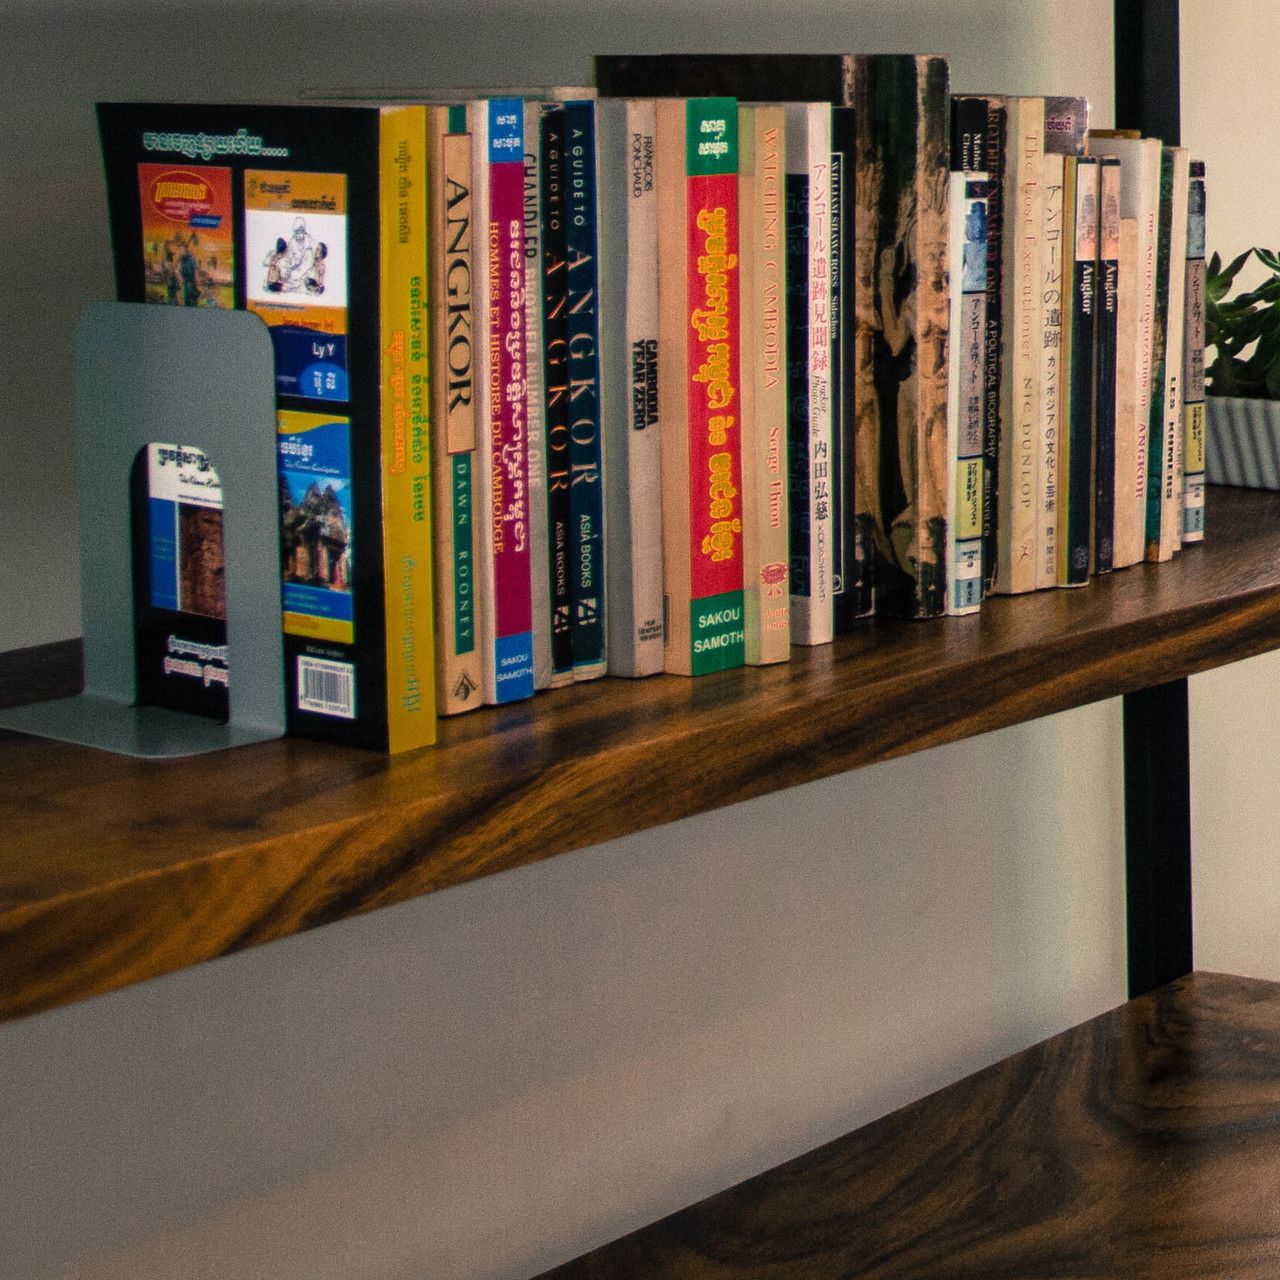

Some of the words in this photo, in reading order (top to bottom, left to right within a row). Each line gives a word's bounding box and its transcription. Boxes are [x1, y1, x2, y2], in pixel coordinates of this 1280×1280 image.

[549, 148, 559, 202] GUIDE
[571, 147, 584, 199] GUIDE
[633, 133, 642, 198] PONCHAUD
[1025, 134, 1038, 168] The
[572, 203, 585, 227] TO
[763, 127, 780, 251] WATCHING
[1025, 182, 1037, 225] Lost
[488, 222, 499, 299] HOMMES
[1043, 185, 1063, 349] アンコールの遺跡
[446, 178, 473, 413] ANGKOR
[1022, 235, 1036, 361] Executioner
[1082, 264, 1094, 315] Angkor
[1105, 264, 1117, 312] Angkor
[489, 307, 500, 327] ET
[763, 261, 780, 389] CAMBODIA
[490, 334, 501, 415] HISTOIRE
[546, 250, 568, 493] ANGKOR
[567, 245, 599, 486] ANGKOR
[632, 339, 645, 384] YEAR
[646, 339, 659, 426] CAMBODIA
[988, 330, 997, 387] POLITICAL
[633, 387, 646, 432] ZERO
[818, 377, 827, 413] Angkor
[1022, 377, 1033, 410] NIC
[491, 422, 502, 446] DU
[811, 407, 820, 437] Guide
[986, 391, 997, 458] BIOGRAPHY
[766, 426, 781, 474] Serge
[1021, 423, 1033, 508] DUNLOP
[1136, 422, 1147, 499] ANGKOR
[1166, 421, 1175, 500] KHMERS
[458, 463, 468, 525] DAWN
[492, 453, 504, 553] CAMBODGE
[768, 480, 782, 529] Thion
[580, 515, 592, 543] ASIA
[581, 545, 592, 588] BOOKS
[459, 552, 470, 639] ROONEY
[698, 608, 741, 629] SAKOU
[501, 654, 527, 668] SAKOU
[694, 631, 744, 654] SAMOTH
[497, 668, 532, 682] SAMOTH
